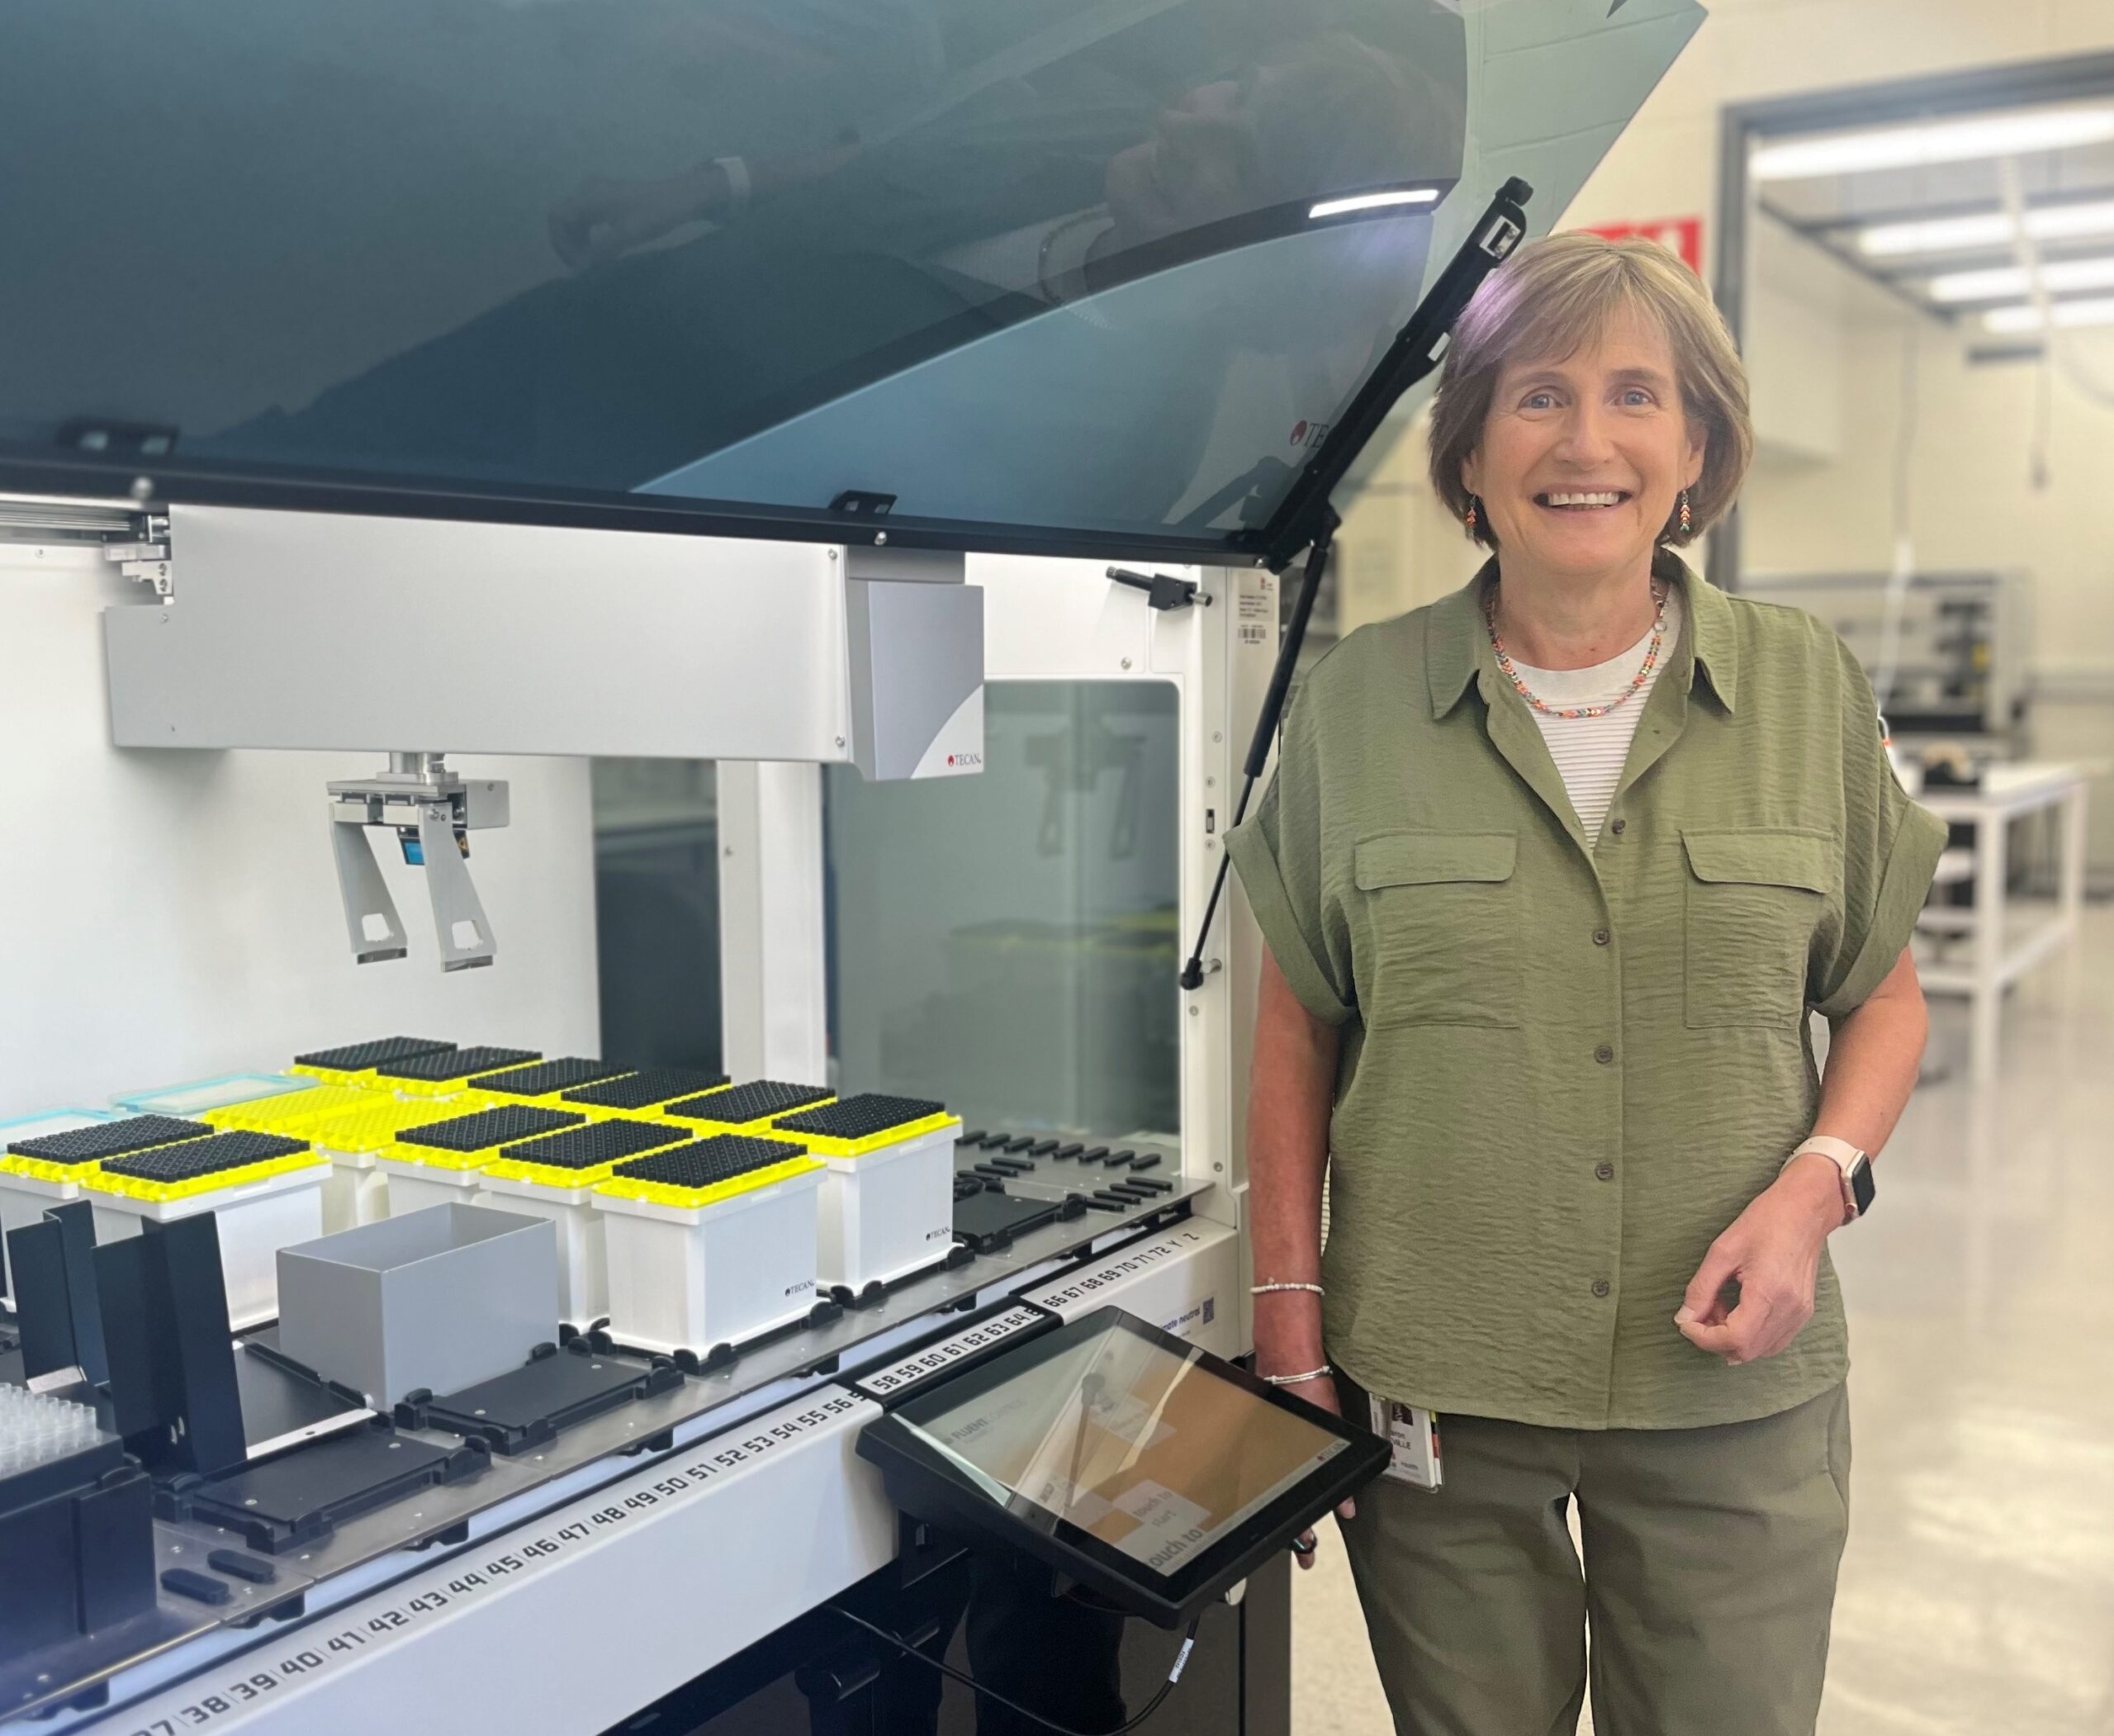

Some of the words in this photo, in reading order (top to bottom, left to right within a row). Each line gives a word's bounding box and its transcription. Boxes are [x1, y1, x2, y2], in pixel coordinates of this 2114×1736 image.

[955, 753, 980, 766] TECAN
[931, 1226, 950, 1240] TECAN
[790, 1279, 814, 1293] TECAN
[1043, 1295, 1068, 1307] 66
[1062, 1287, 1084, 1299] 67
[1080, 1278, 1104, 1290] 68
[1097, 1269, 1121, 1282] 69
[1115, 1262, 1139, 1274] 70
[1133, 1254, 1154, 1264] 71
[1148, 1246, 1172, 1257] 72
[1167, 1240, 1183, 1248] Y
[872, 1374, 902, 1390] 58
[895, 1364, 925, 1378] 59
[918, 1354, 947, 1368] 60
[943, 1344, 968, 1356] 61
[962, 1333, 990, 1345] 62
[984, 1323, 1010, 1335] 63
[1004, 1313, 1031, 1326] 64
[950, 1418, 989, 1440] FLUENT
[1133, 1497, 1162, 1517] touch
[1157, 1491, 1173, 1501] to
[181, 1696, 231, 1724] 38
[230, 1673, 278, 1701] 39
[280, 1652, 324, 1675] 40
[327, 1631, 366, 1653] 41
[367, 1611, 410, 1634] 42
[409, 1591, 448, 1611] 43
[448, 1572, 488, 1592] 44
[486, 1555, 524, 1576] 45
[522, 1539, 560, 1559] 46
[557, 1523, 590, 1540] 47
[590, 1506, 627, 1525] 48
[624, 1492, 658, 1510] 49
[653, 1477, 689, 1496] 50
[686, 1463, 718, 1480] 51
[714, 1449, 748, 1467] 52
[741, 1436, 775, 1453] 53
[769, 1423, 803, 1439] 54
[797, 1410, 829, 1426] 55
[822, 1397, 855, 1414] 56
[1149, 1539, 1187, 1568] ouch
[1181, 1529, 1203, 1543] to
